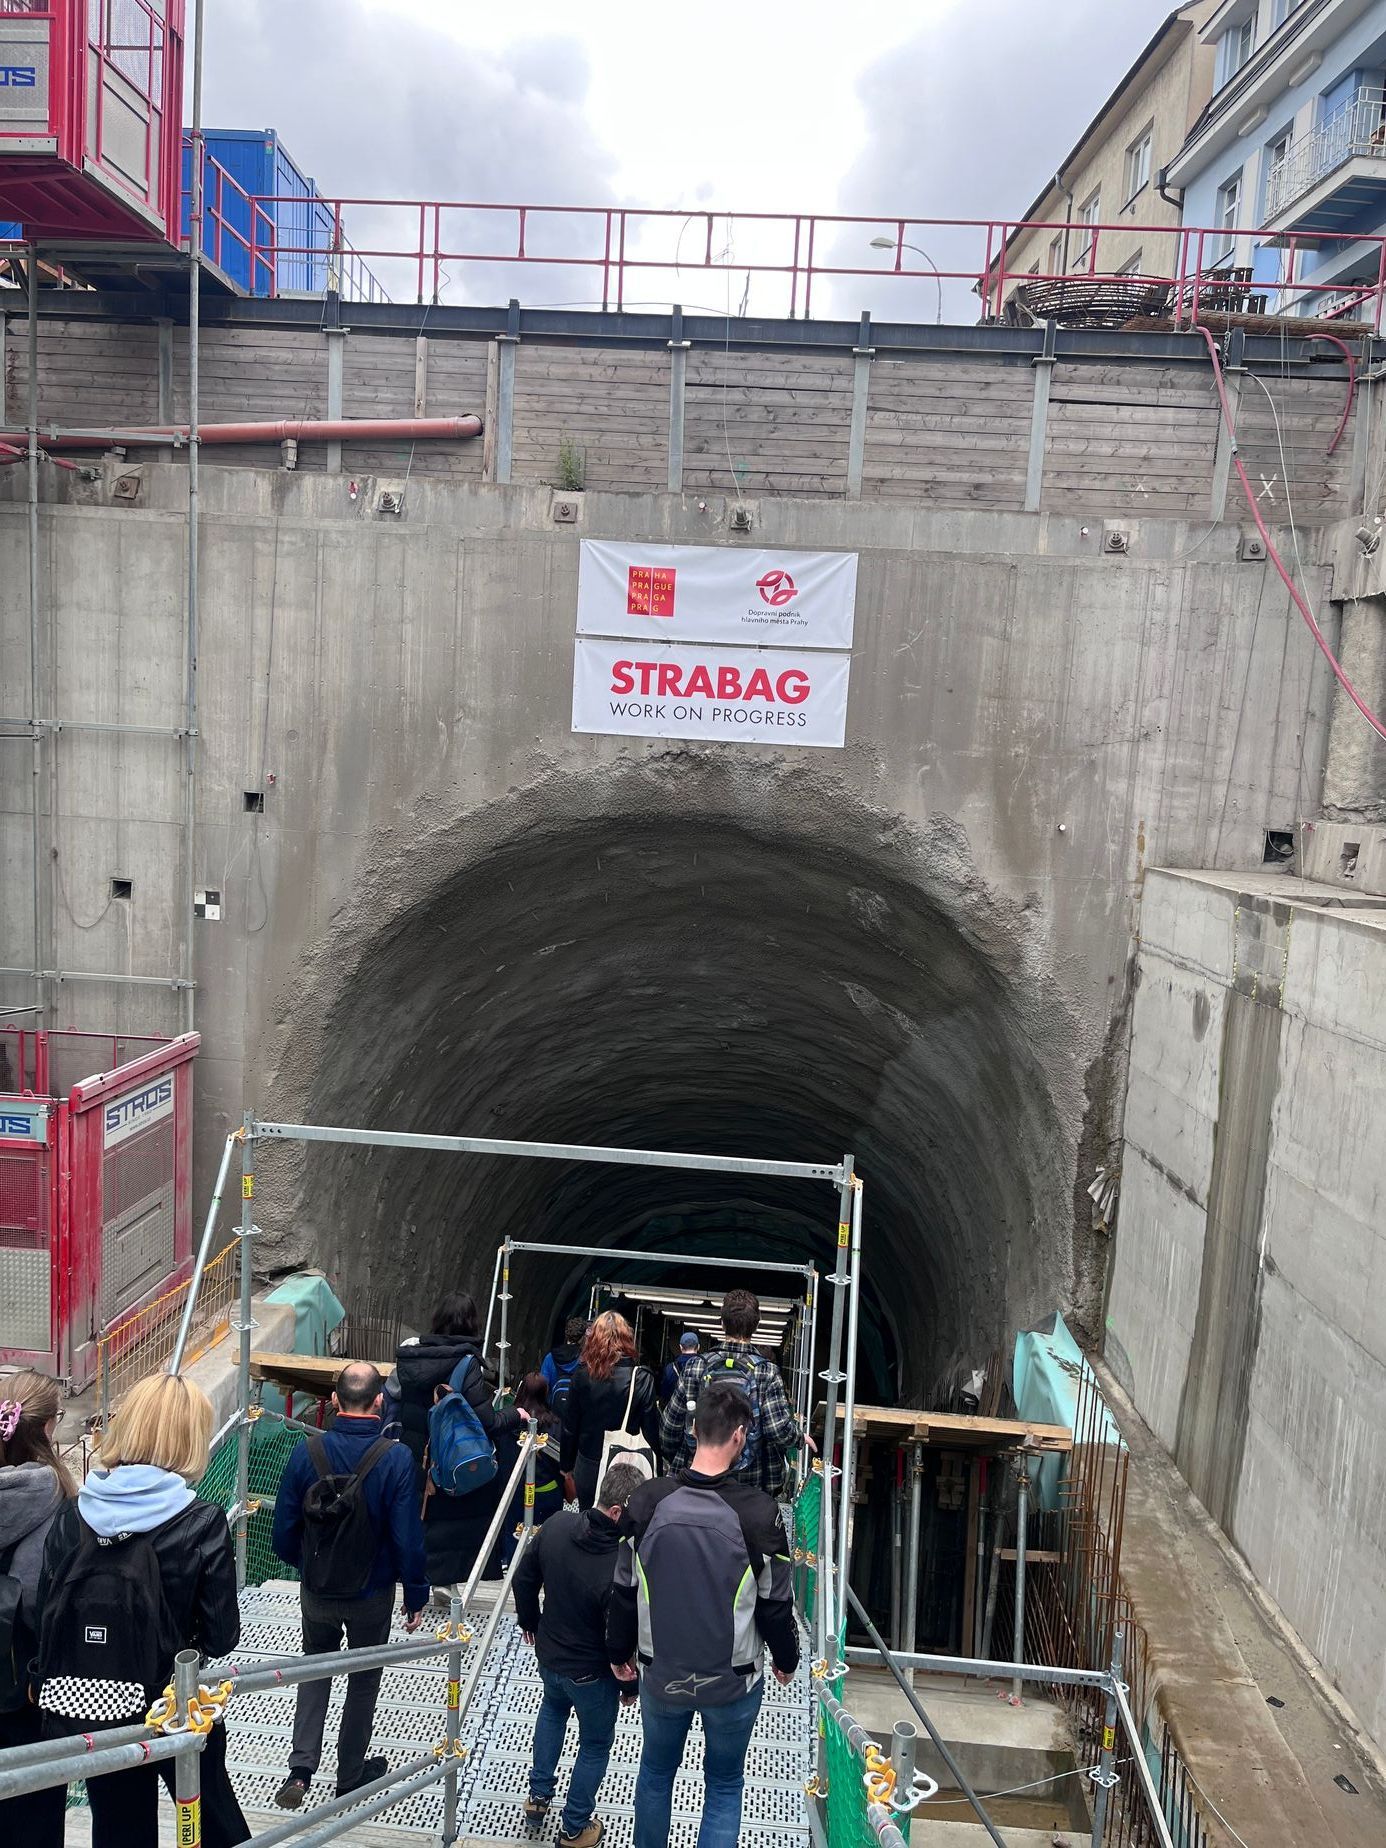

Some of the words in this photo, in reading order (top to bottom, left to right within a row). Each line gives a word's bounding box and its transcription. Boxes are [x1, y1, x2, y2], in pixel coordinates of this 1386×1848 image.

[741, 616, 769, 624] hlavního
[769, 617, 789, 625] města
[790, 619, 808, 627] Prahy
[778, 610, 801, 618] podnik
[610, 660, 811, 705] STRABAG
[610, 702, 666, 720] WORK
[673, 705, 703, 721] ON
[712, 708, 807, 727] PROGRESS
[106, 1078, 172, 1131] STROS
[0, 1116, 31, 1134] S
[181, 1806, 192, 1821] UP
[181, 1823, 191, 1843] PERI
